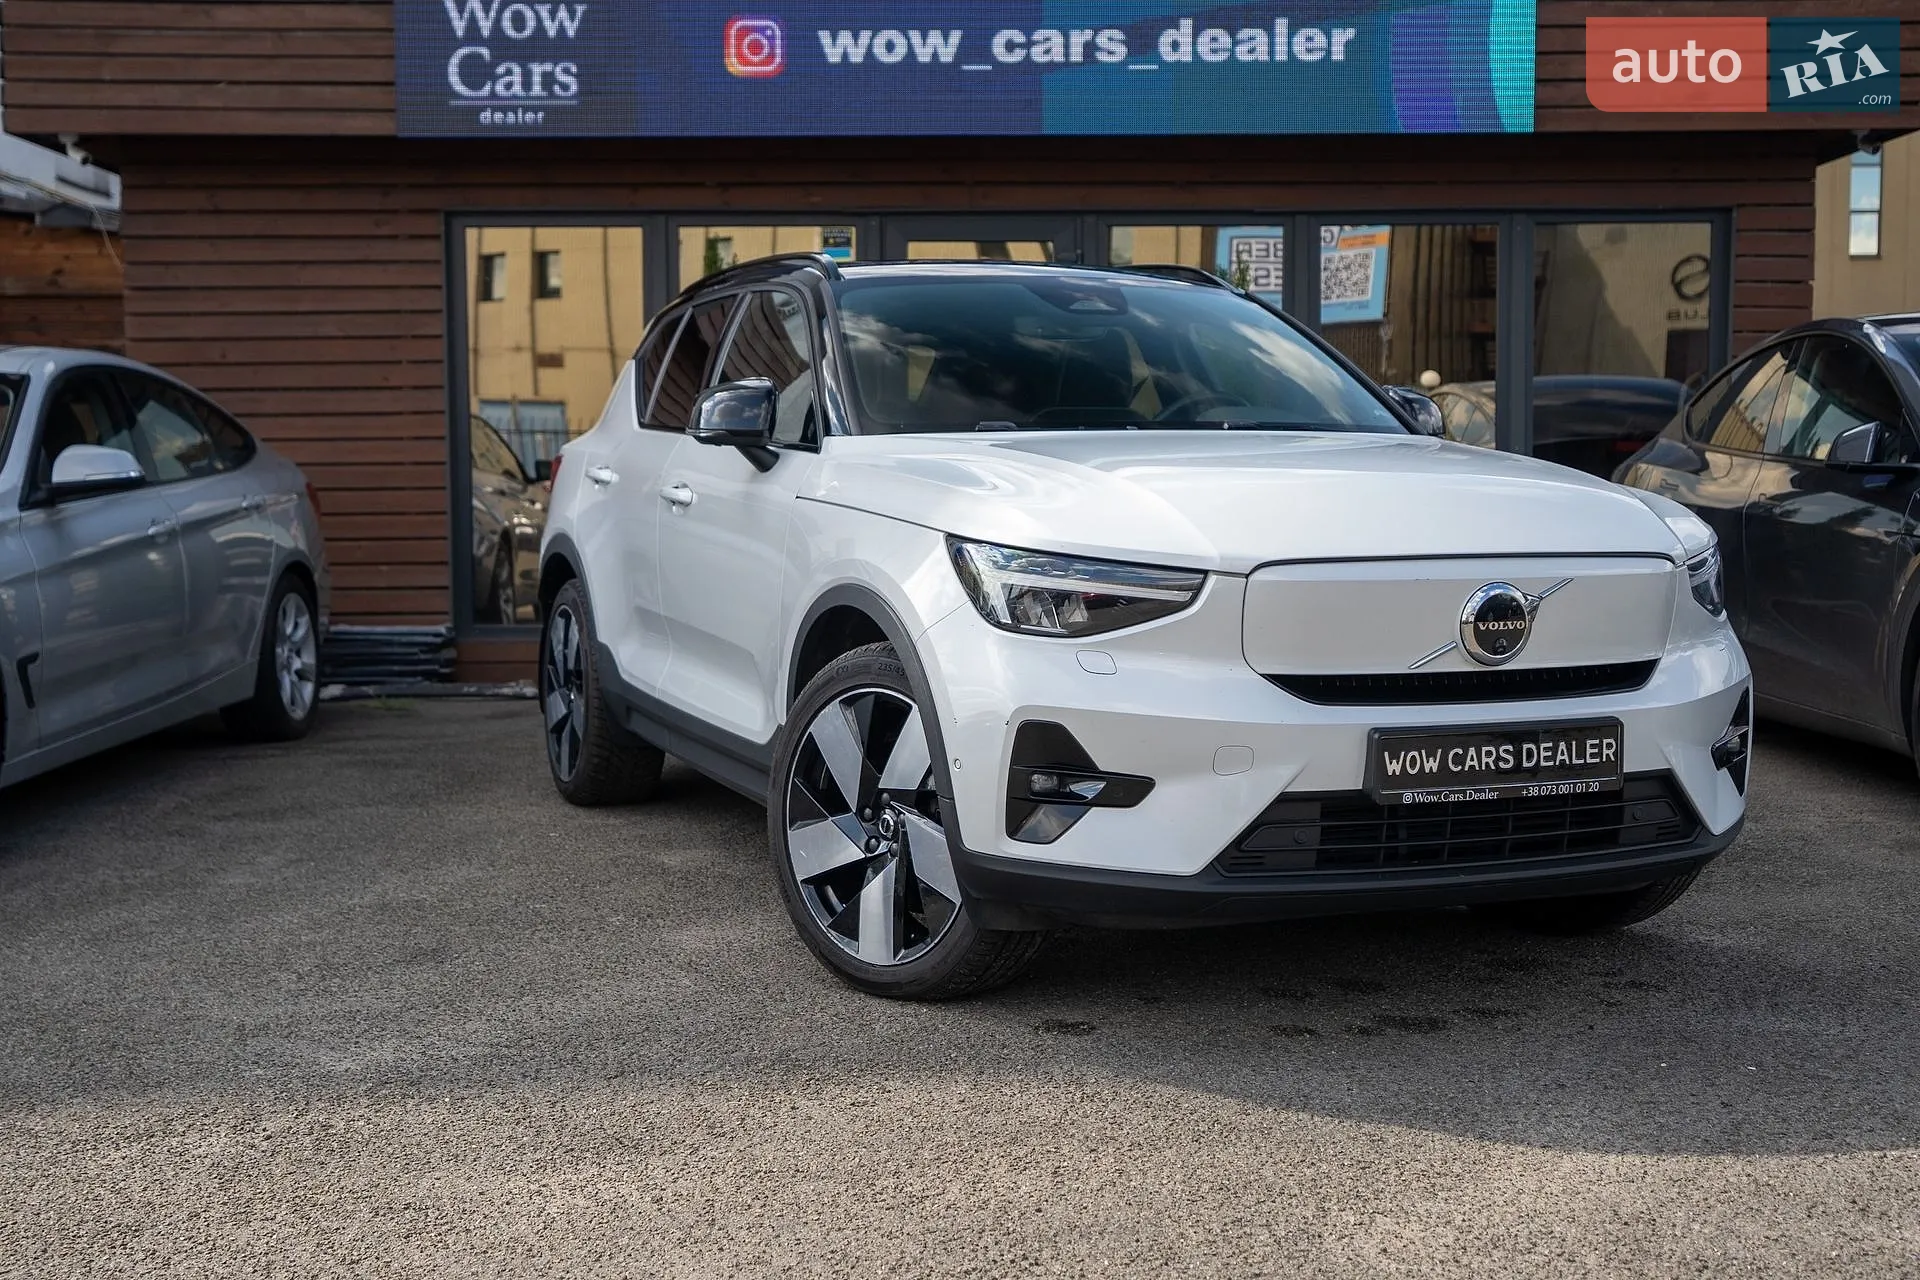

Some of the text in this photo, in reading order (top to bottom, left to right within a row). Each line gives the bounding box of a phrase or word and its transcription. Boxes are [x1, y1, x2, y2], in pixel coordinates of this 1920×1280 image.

[443, 0, 587, 39] Wow
[817, 18, 1356, 69] wow_cars_dealer
[448, 46, 578, 96] Cars
[479, 108, 545, 124] dealer
[1477, 620, 1526, 631] VOLVO
[1383, 738, 1617, 776] WOW CARS DEALER
[1521, 782, 1600, 797] +38 073 001 01 20
